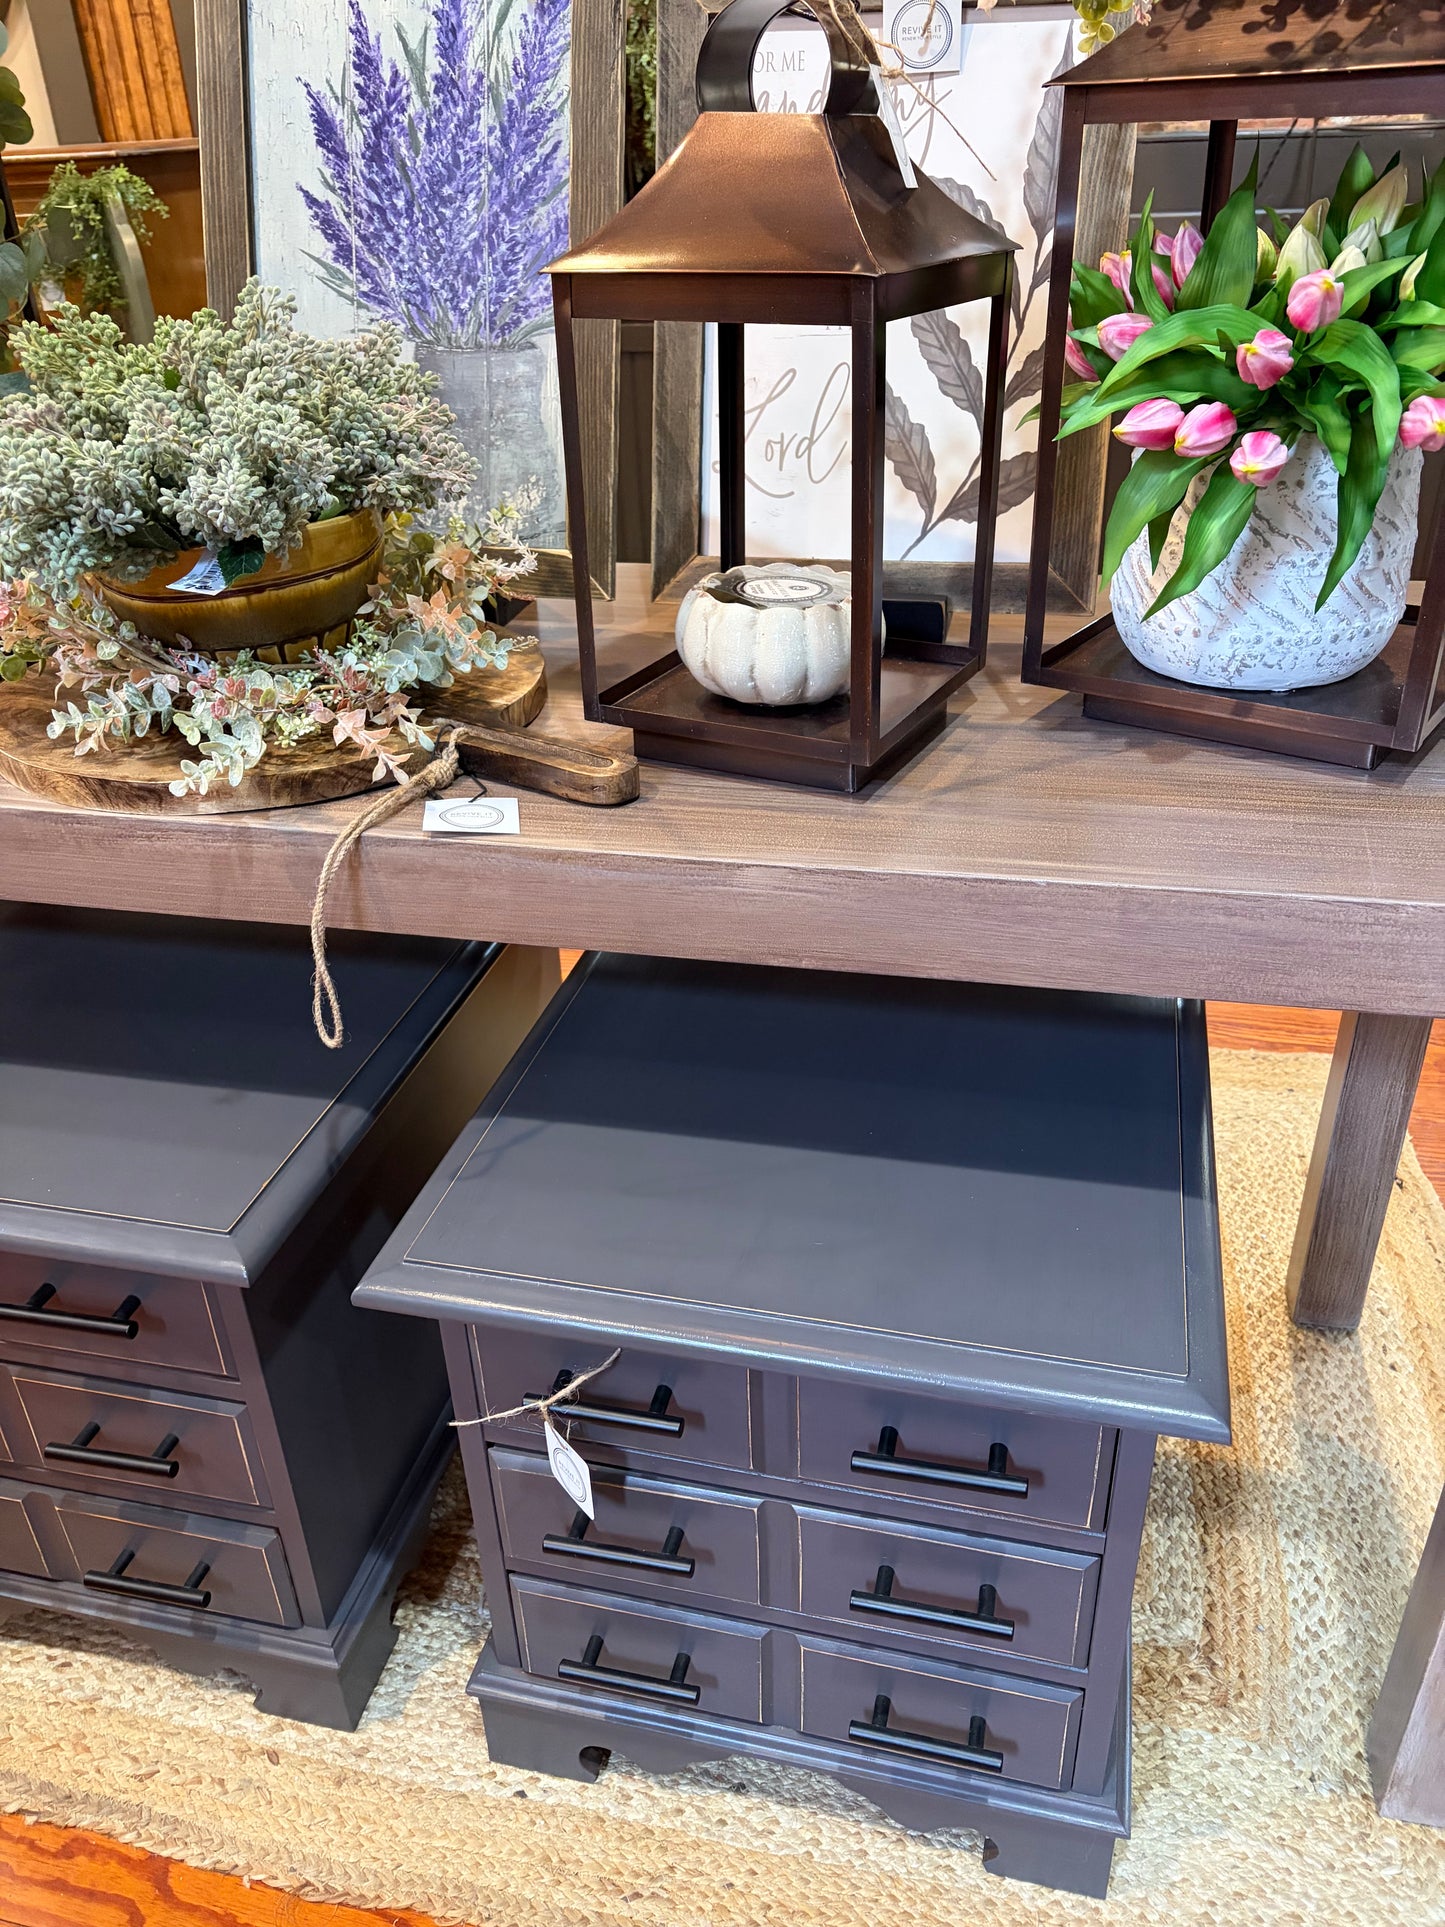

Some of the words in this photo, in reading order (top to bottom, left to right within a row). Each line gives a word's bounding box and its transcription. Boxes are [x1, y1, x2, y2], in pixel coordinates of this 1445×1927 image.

[934, 24, 942, 33] IT
[753, 51, 777, 73] OR
[781, 50, 806, 72] ME
[712, 362, 851, 499] Lord
